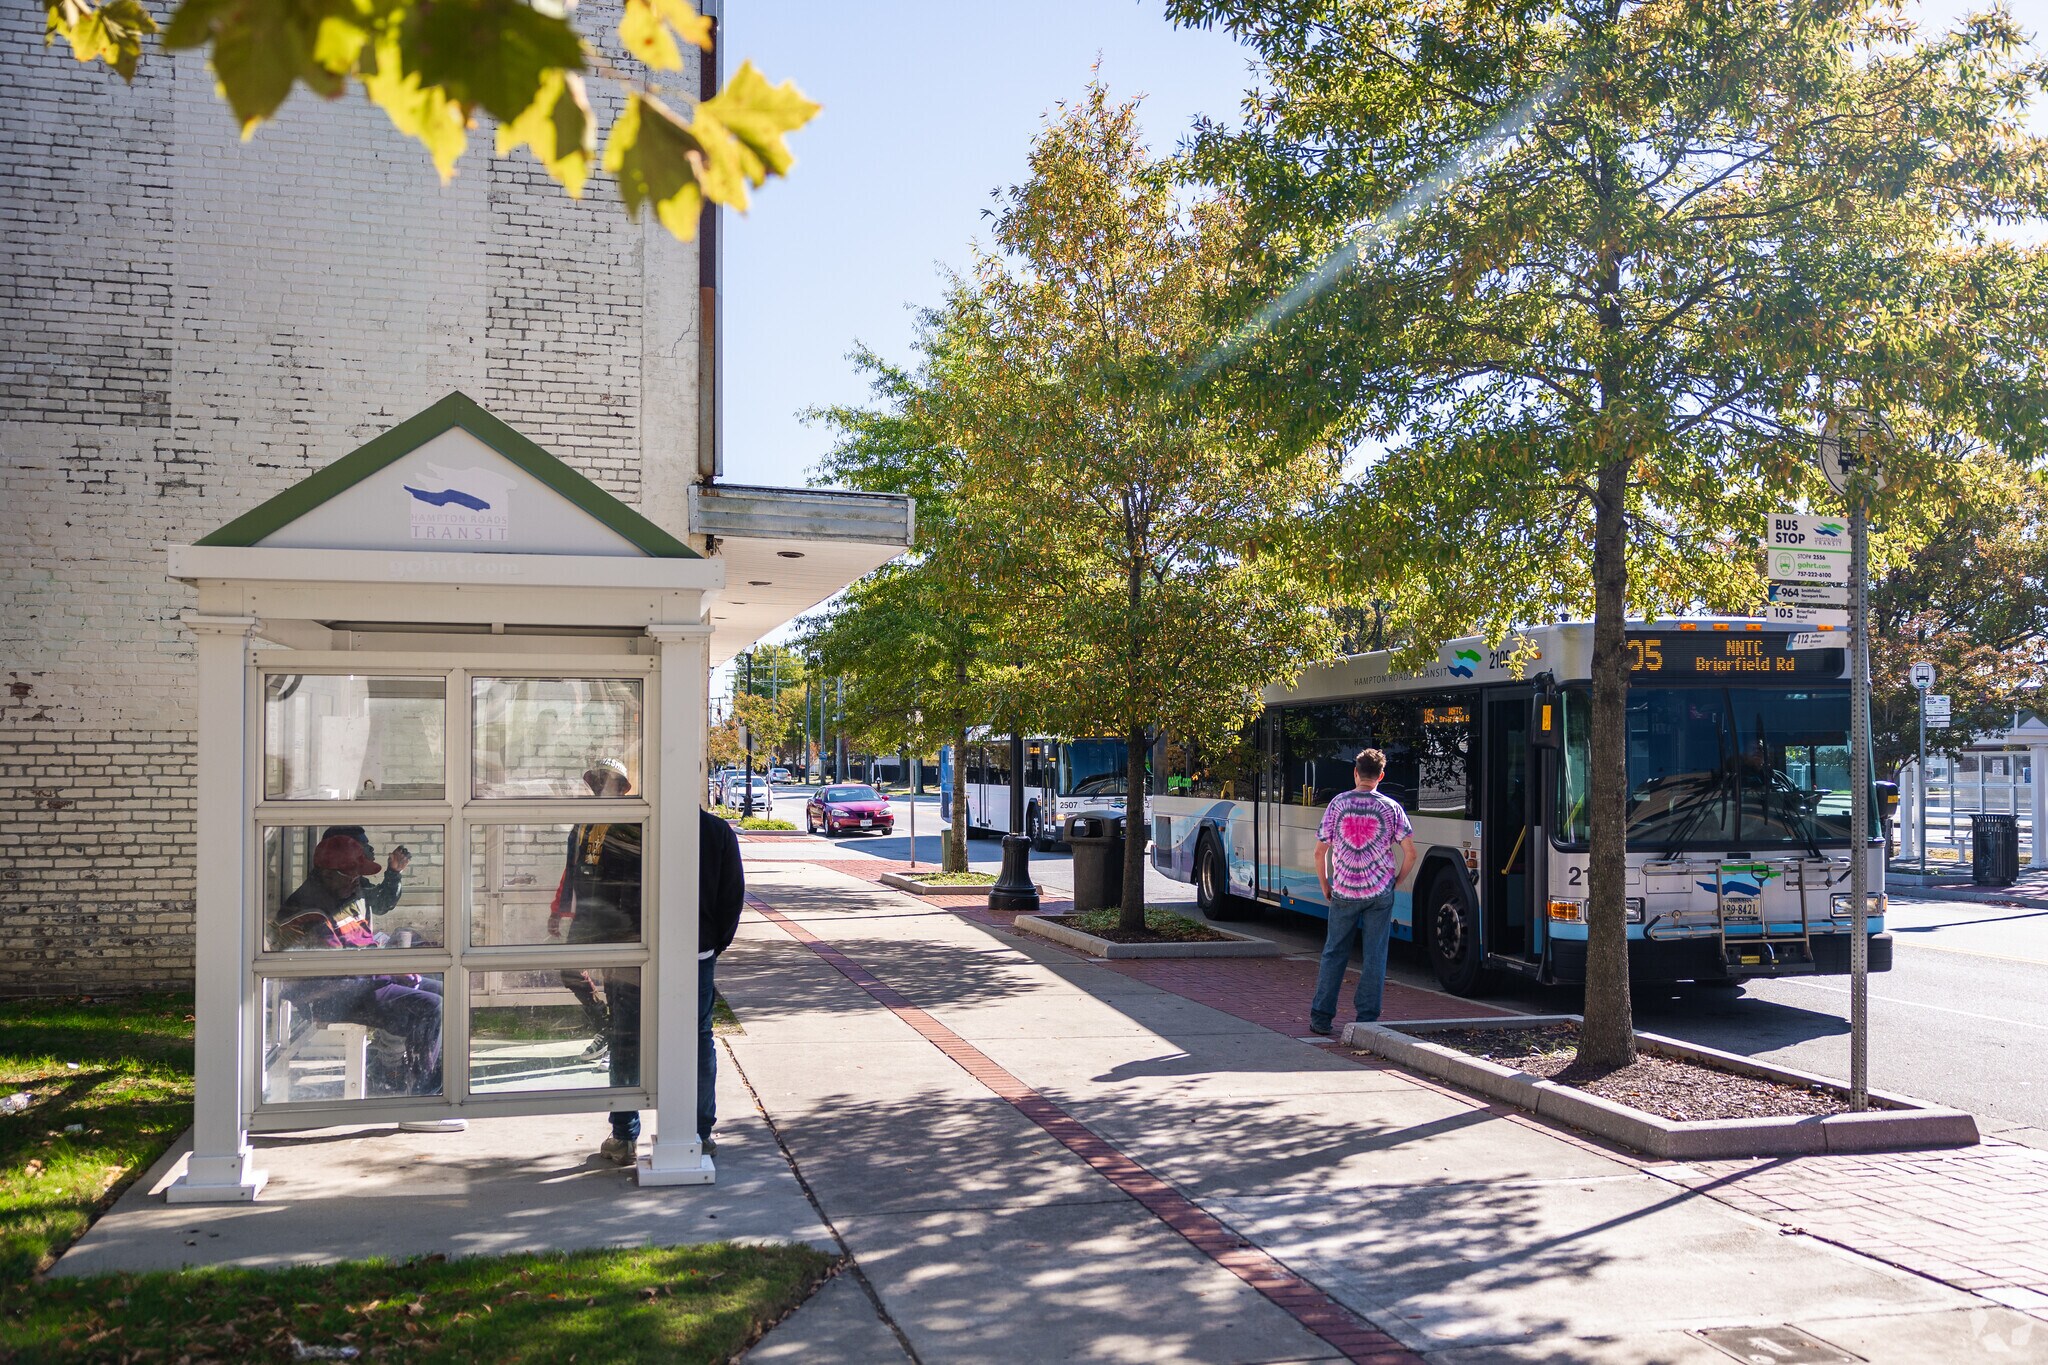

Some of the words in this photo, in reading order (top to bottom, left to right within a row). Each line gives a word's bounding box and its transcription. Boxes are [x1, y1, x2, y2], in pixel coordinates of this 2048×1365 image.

[411, 512, 466, 523] HAMPTON
[470, 514, 507, 525] ROADS
[1775, 518, 1798, 531] BUS
[411, 526, 507, 540] TRANSIT
[1775, 532, 1806, 545] STOP
[388, 556, 521, 578] gohrt.com
[1797, 561, 1832, 570] gohrt.com
[1797, 570, 1832, 578] 757-222-6100
[1781, 587, 1800, 598] 964
[1774, 607, 1794, 618] 105
[1797, 633, 1810, 644] 112
[1626, 639, 1663, 671] 05
[1725, 640, 1764, 656] NNTC
[1695, 657, 1770, 671] Briarfield
[1776, 657, 1796, 671] Rd
[1354, 675, 1387, 687] HAMPTON
[1388, 671, 1413, 682] ROADS
[1414, 667, 1447, 678] RANSIT
[1060, 801, 1079, 809] 2507
[1568, 866, 1589, 886] 2
